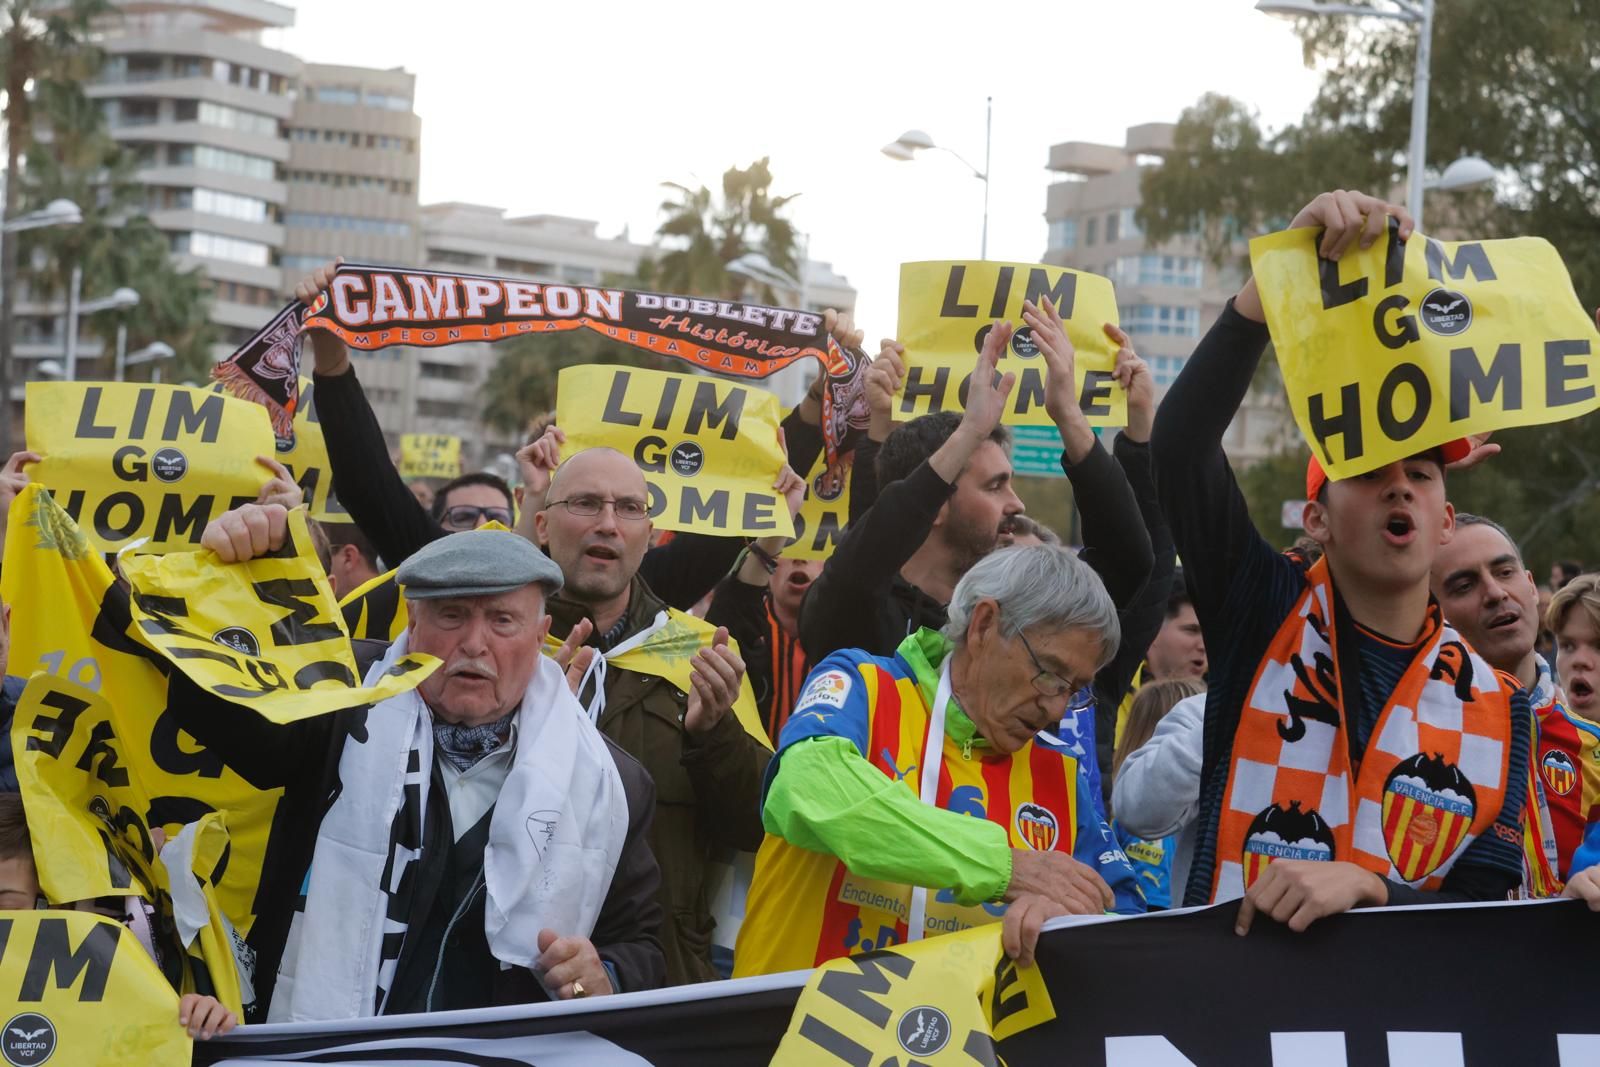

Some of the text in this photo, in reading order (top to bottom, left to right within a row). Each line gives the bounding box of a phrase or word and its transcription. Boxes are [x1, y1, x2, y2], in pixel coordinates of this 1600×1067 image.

[1315, 214, 1497, 310] LIM
[331, 273, 624, 326] CAMPEON
[940, 265, 1077, 320] LIM
[635, 293, 823, 337] DOBLETE
[483, 321, 558, 338] LIGA
[607, 326, 679, 352] UEFA
[75, 387, 225, 443] LIM
[601, 371, 747, 440] LIM
[1308, 339, 1596, 465] HOME
[1395, 782, 1469, 815] VALENCIA C.F.
[1251, 842, 1302, 859] VALENCIA
[10, 1042, 47, 1050] LIBERTAD
[920, 1017, 938, 1049] LIBERTAD
[931, 1028, 940, 1042] VCF
[20, 1049, 36, 1057] VCF
